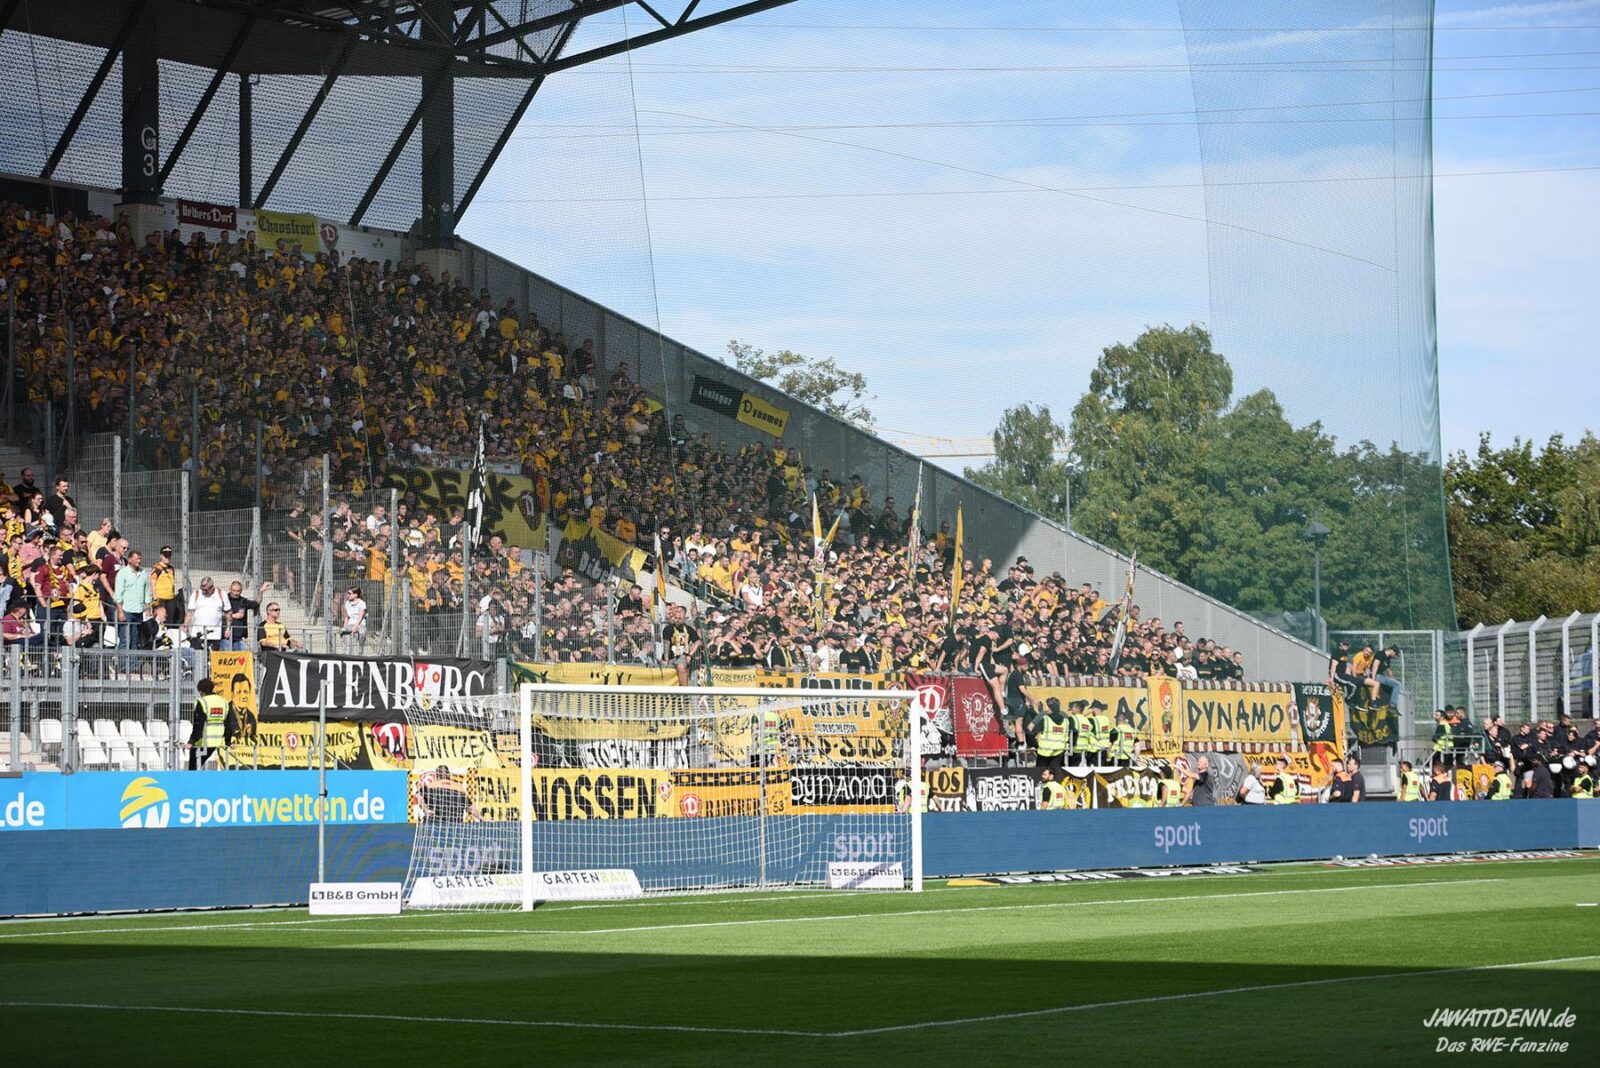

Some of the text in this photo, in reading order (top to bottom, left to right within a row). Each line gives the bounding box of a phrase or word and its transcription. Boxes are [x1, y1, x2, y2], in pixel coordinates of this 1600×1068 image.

[141, 126, 157, 150] G
[143, 153, 154, 176] 3
[269, 658, 485, 717] ALTENBRG
[1187, 698, 1284, 733] DYNAMO
[532, 773, 657, 820] NOSSEN
[791, 774, 887, 804] DYNAMO
[977, 775, 1036, 801] DRESDEN
[1106, 775, 1160, 803] FREITA
[179, 789, 385, 827] sportwetten.de
[1154, 821, 1202, 854] sport
[1409, 814, 1449, 844] sport
[835, 831, 895, 863] sport
[356, 890, 399, 900] GmbH
